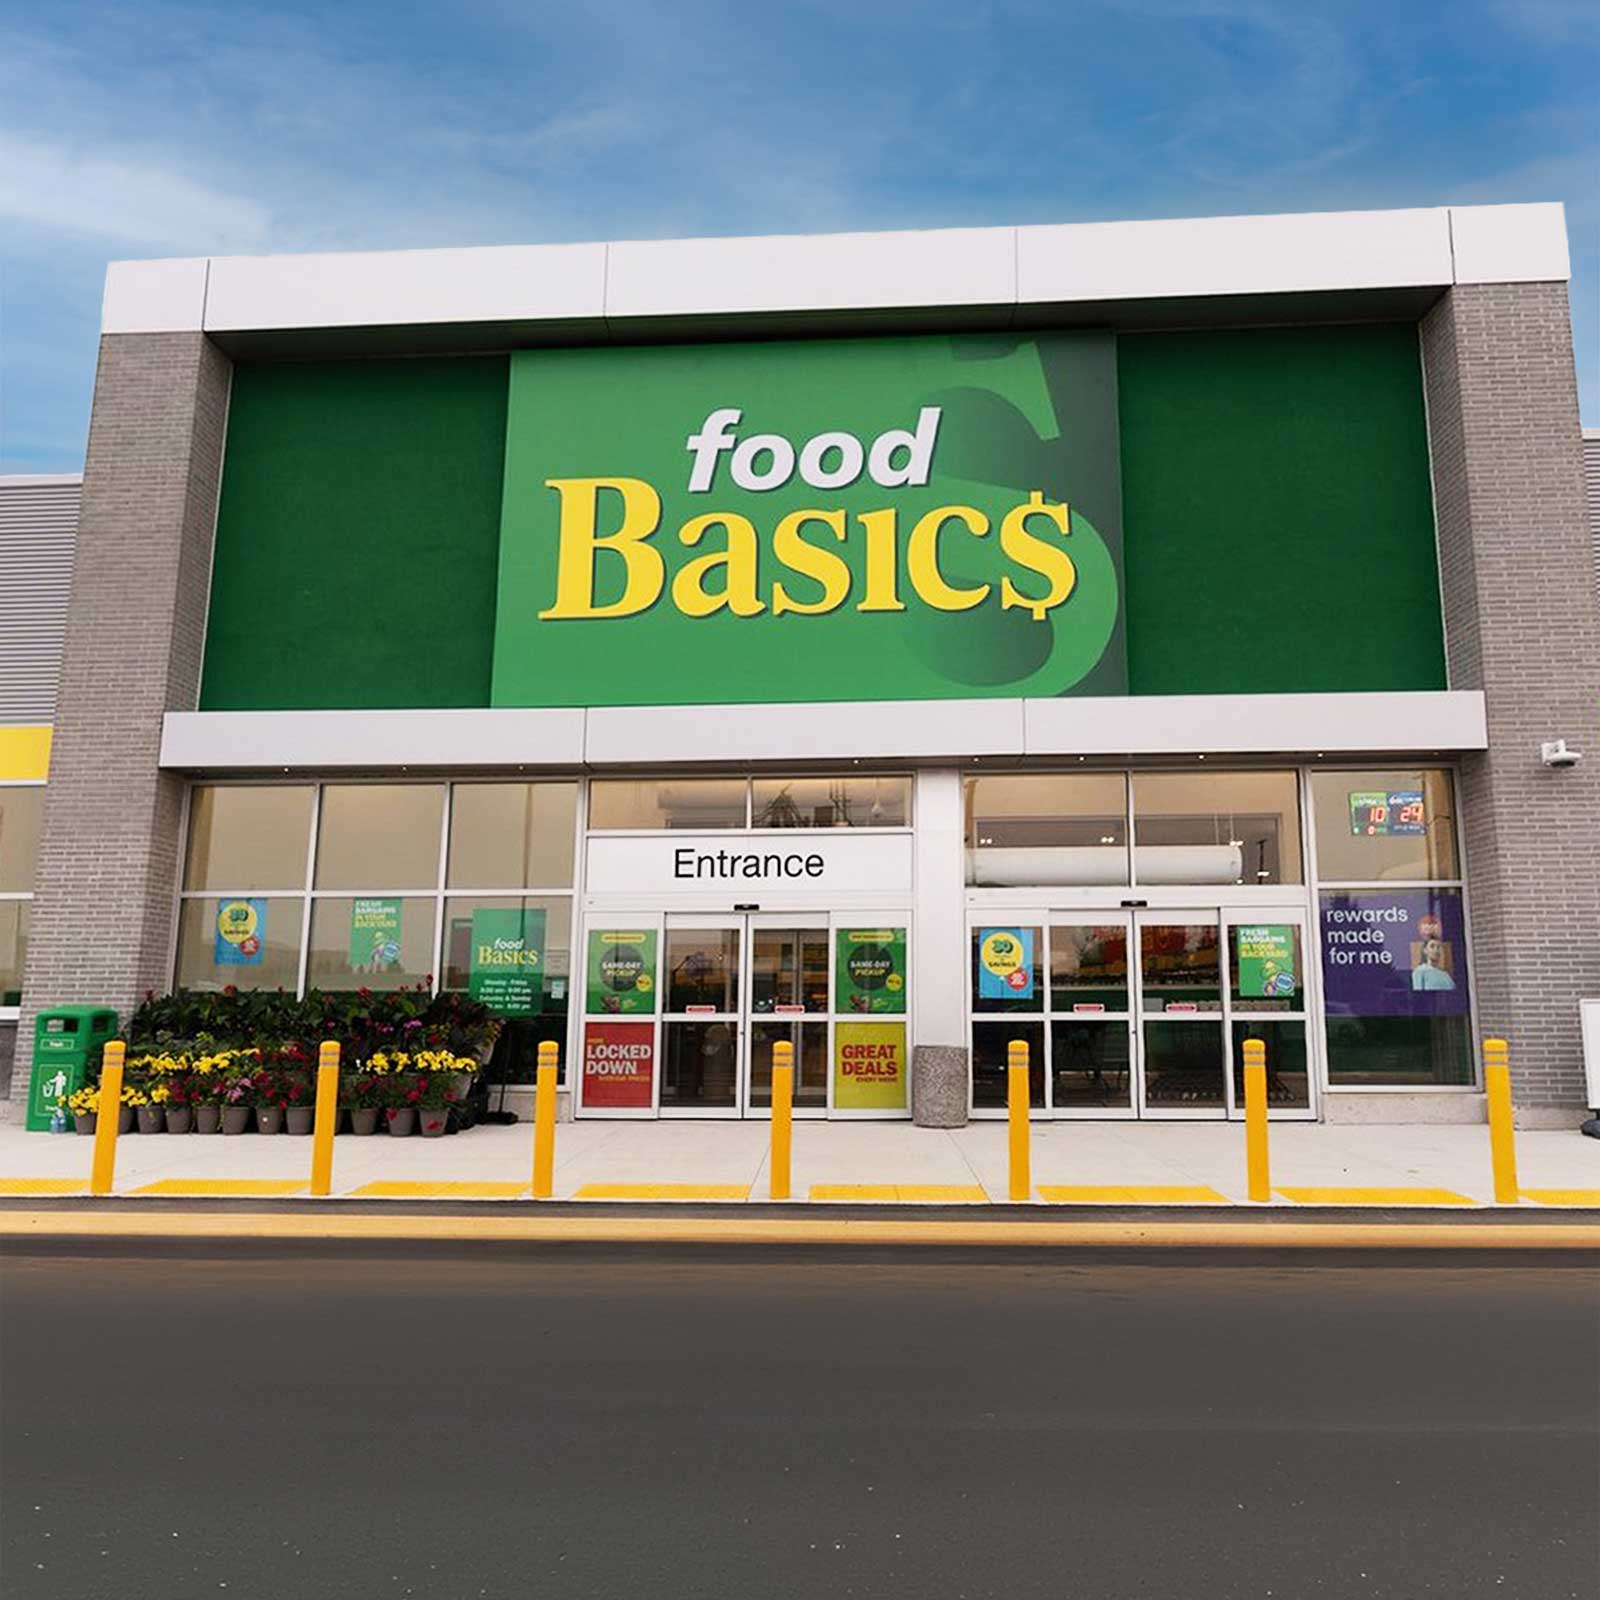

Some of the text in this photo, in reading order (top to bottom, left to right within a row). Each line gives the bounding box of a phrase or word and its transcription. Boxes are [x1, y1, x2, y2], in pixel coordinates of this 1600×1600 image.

[687, 407, 942, 492] food
[1370, 806, 1386, 823] 10
[674, 848, 825, 878] Entrance
[1326, 905, 1408, 922] rewards
[494, 937, 525, 950] food
[1328, 927, 1385, 944] made
[1330, 947, 1393, 965] for me
[586, 1044, 652, 1060] LOCKED
[841, 1044, 898, 1060] GREAT
[585, 1060, 637, 1075] DOWN
[842, 1060, 899, 1076] DEALS
